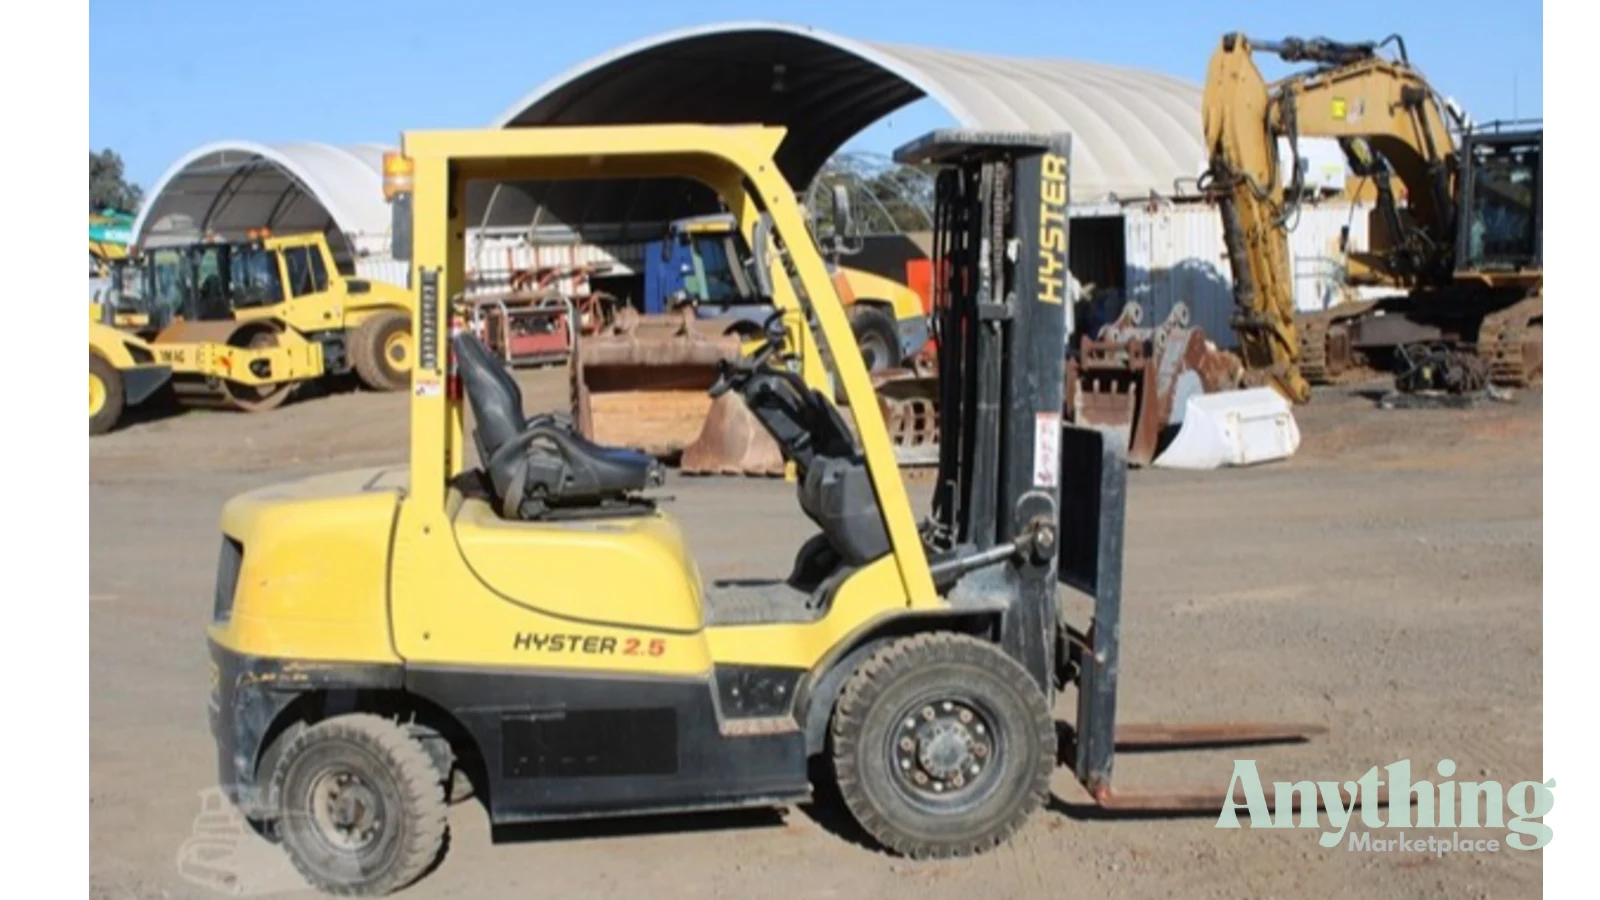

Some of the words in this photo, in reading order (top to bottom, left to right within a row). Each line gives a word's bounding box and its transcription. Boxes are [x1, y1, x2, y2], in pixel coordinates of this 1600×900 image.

[1037, 153, 1068, 305] HYSTER
[513, 631, 618, 655] HYSTER
[622, 637, 666, 657] 2.5
